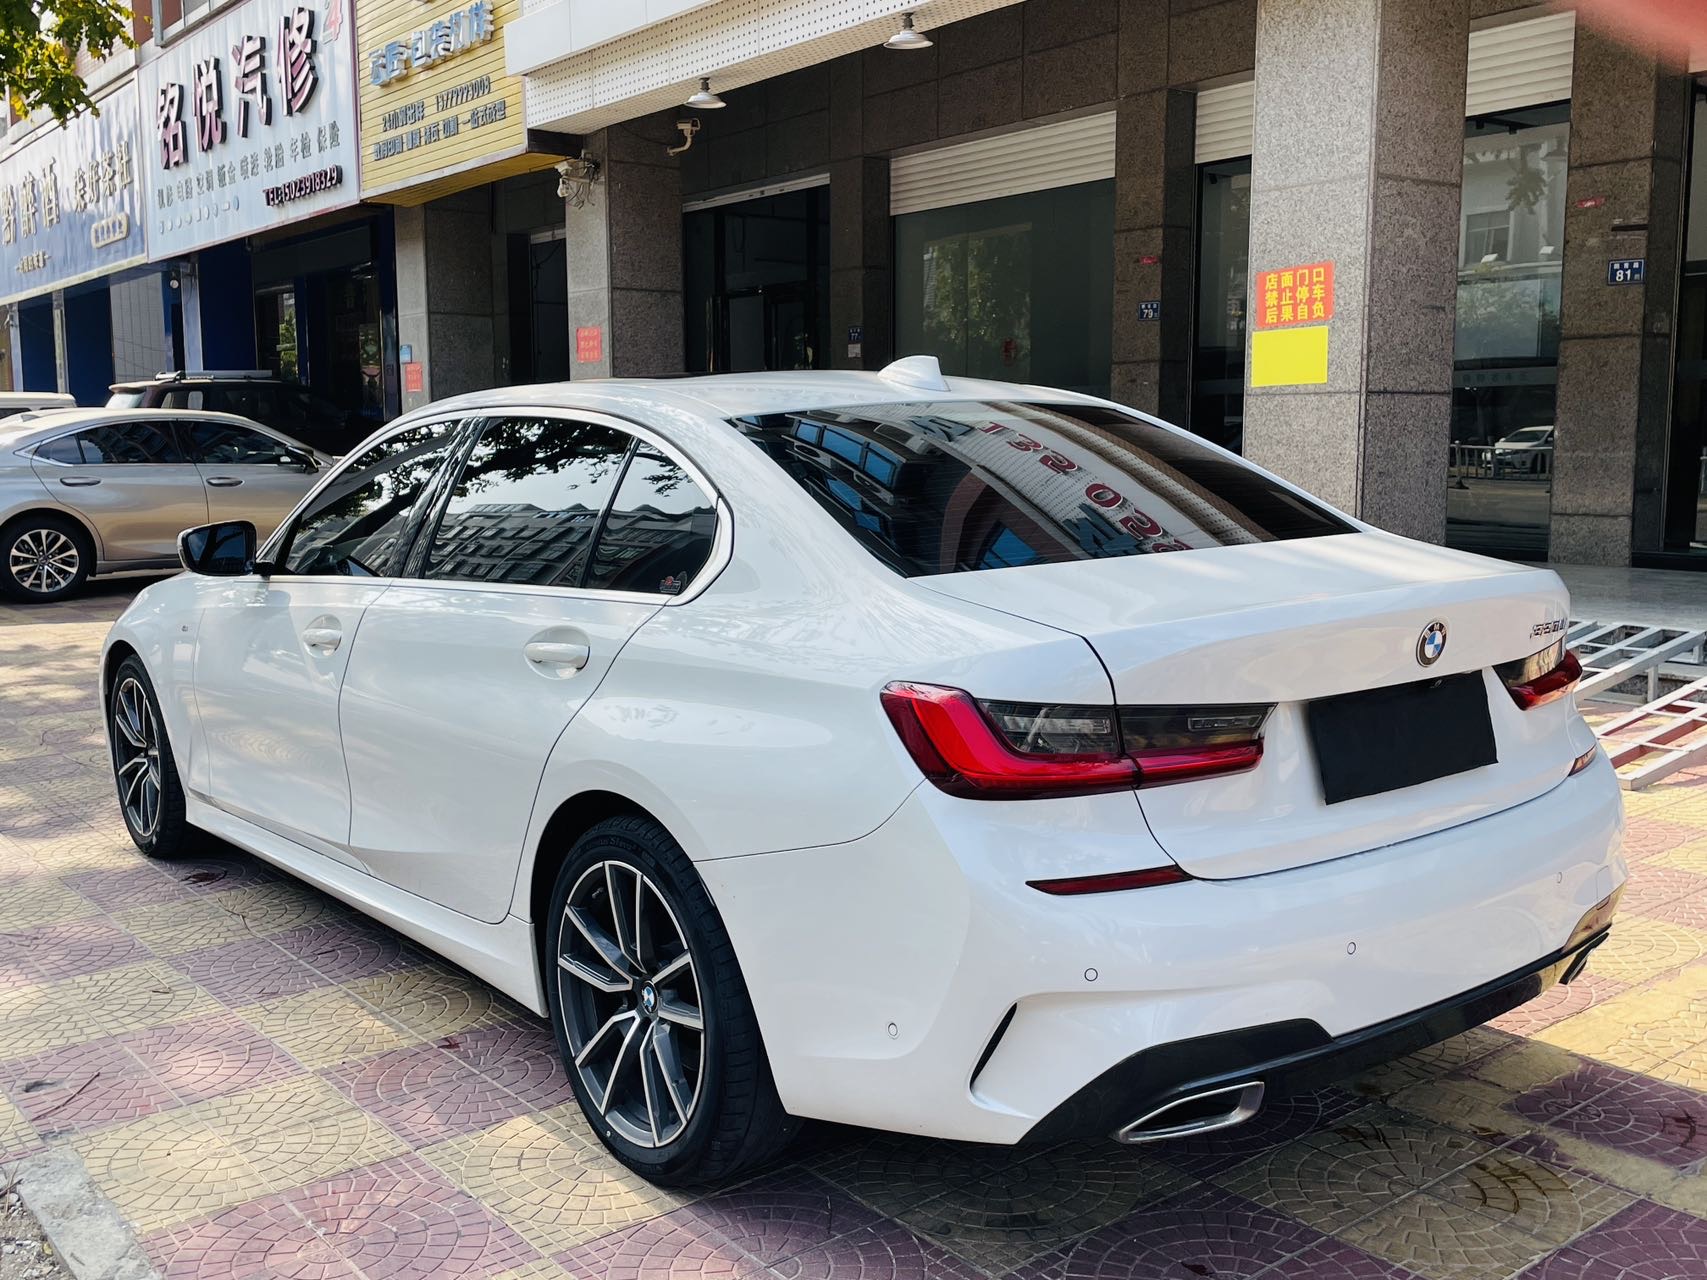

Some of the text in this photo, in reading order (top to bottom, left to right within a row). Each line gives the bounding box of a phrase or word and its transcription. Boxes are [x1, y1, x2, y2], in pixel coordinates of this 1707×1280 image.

[156, 7, 319, 169] 铭悦汽修
[1265, 267, 1325, 290] 店面门口
[1615, 269, 1632, 282] 81
[1265, 284, 1326, 307] 禁止停车
[1265, 301, 1325, 324] 后果自负
